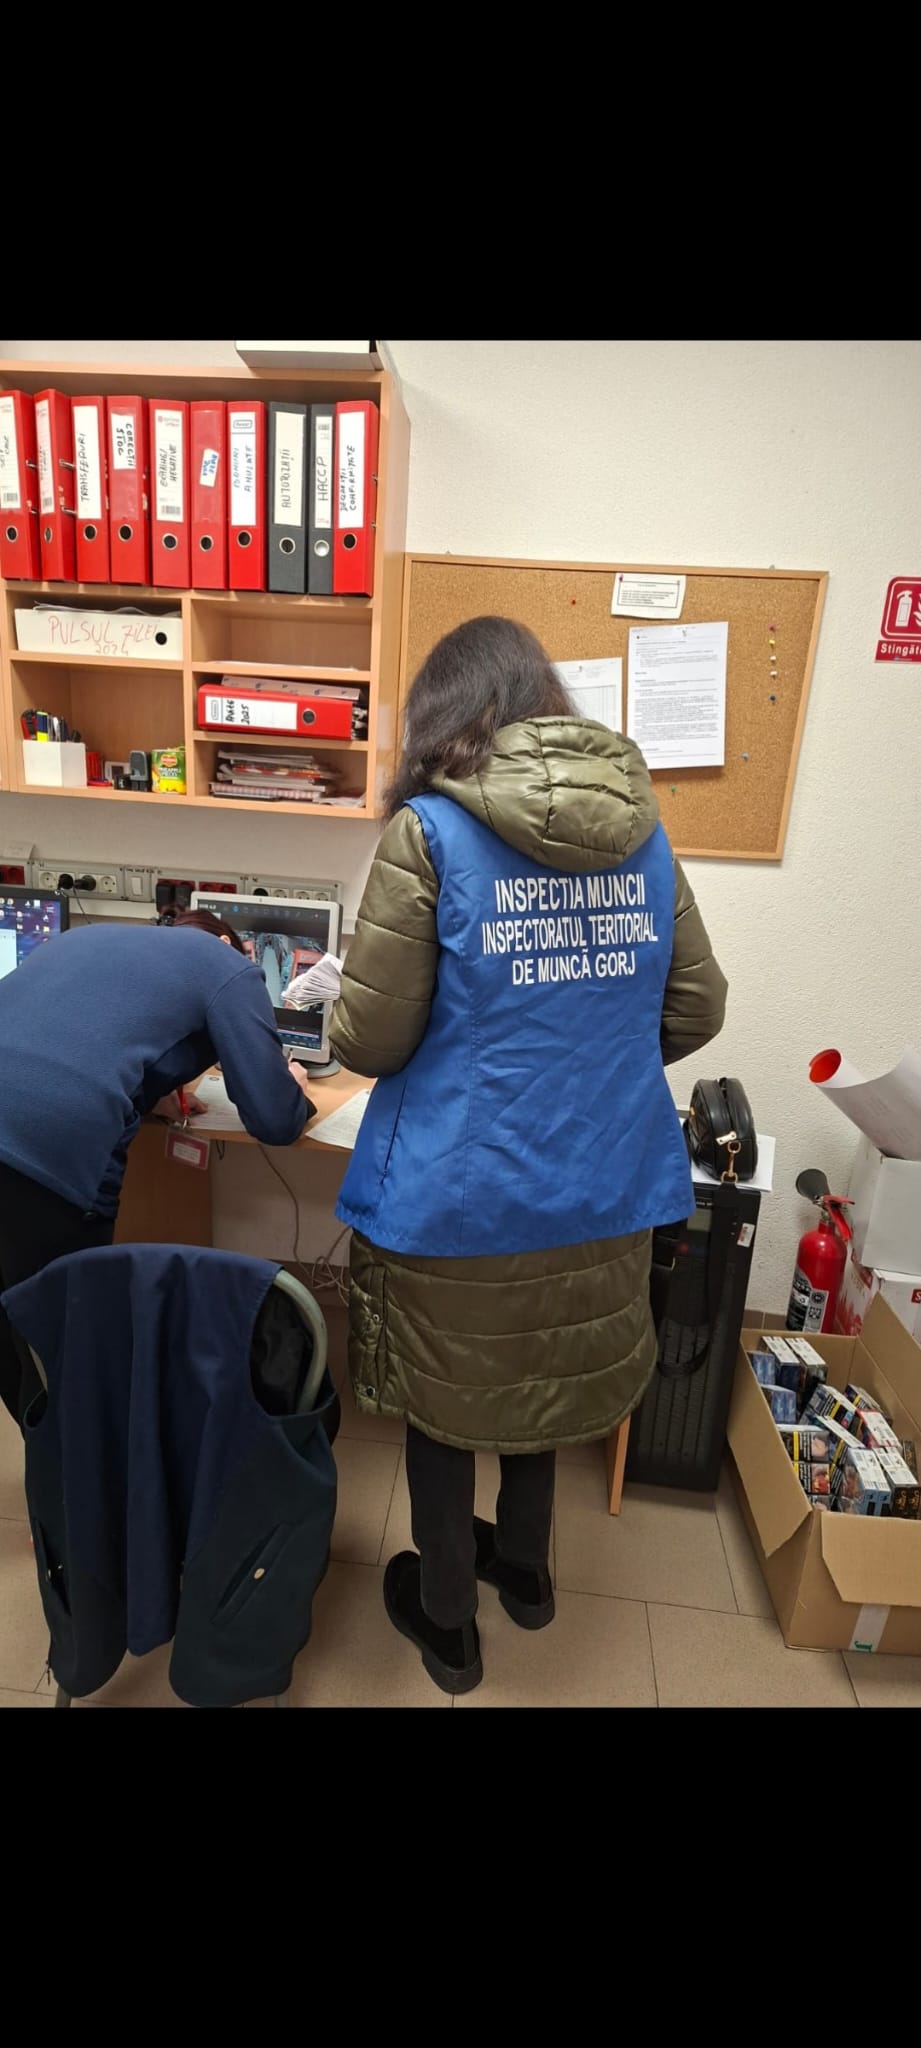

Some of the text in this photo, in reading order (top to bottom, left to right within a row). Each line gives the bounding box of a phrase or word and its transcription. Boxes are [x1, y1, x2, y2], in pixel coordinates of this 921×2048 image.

[316, 456, 328, 501] HACCP
[48, 615, 113, 645] PULSUL
[241, 704, 250, 725] 2025
[494, 873, 645, 913] INSPECTIA MUNCII
[482, 912, 659, 955] INSPECTORATUL TERITORIAL
[512, 958, 535, 985] DE
[595, 950, 636, 978] GORJ
